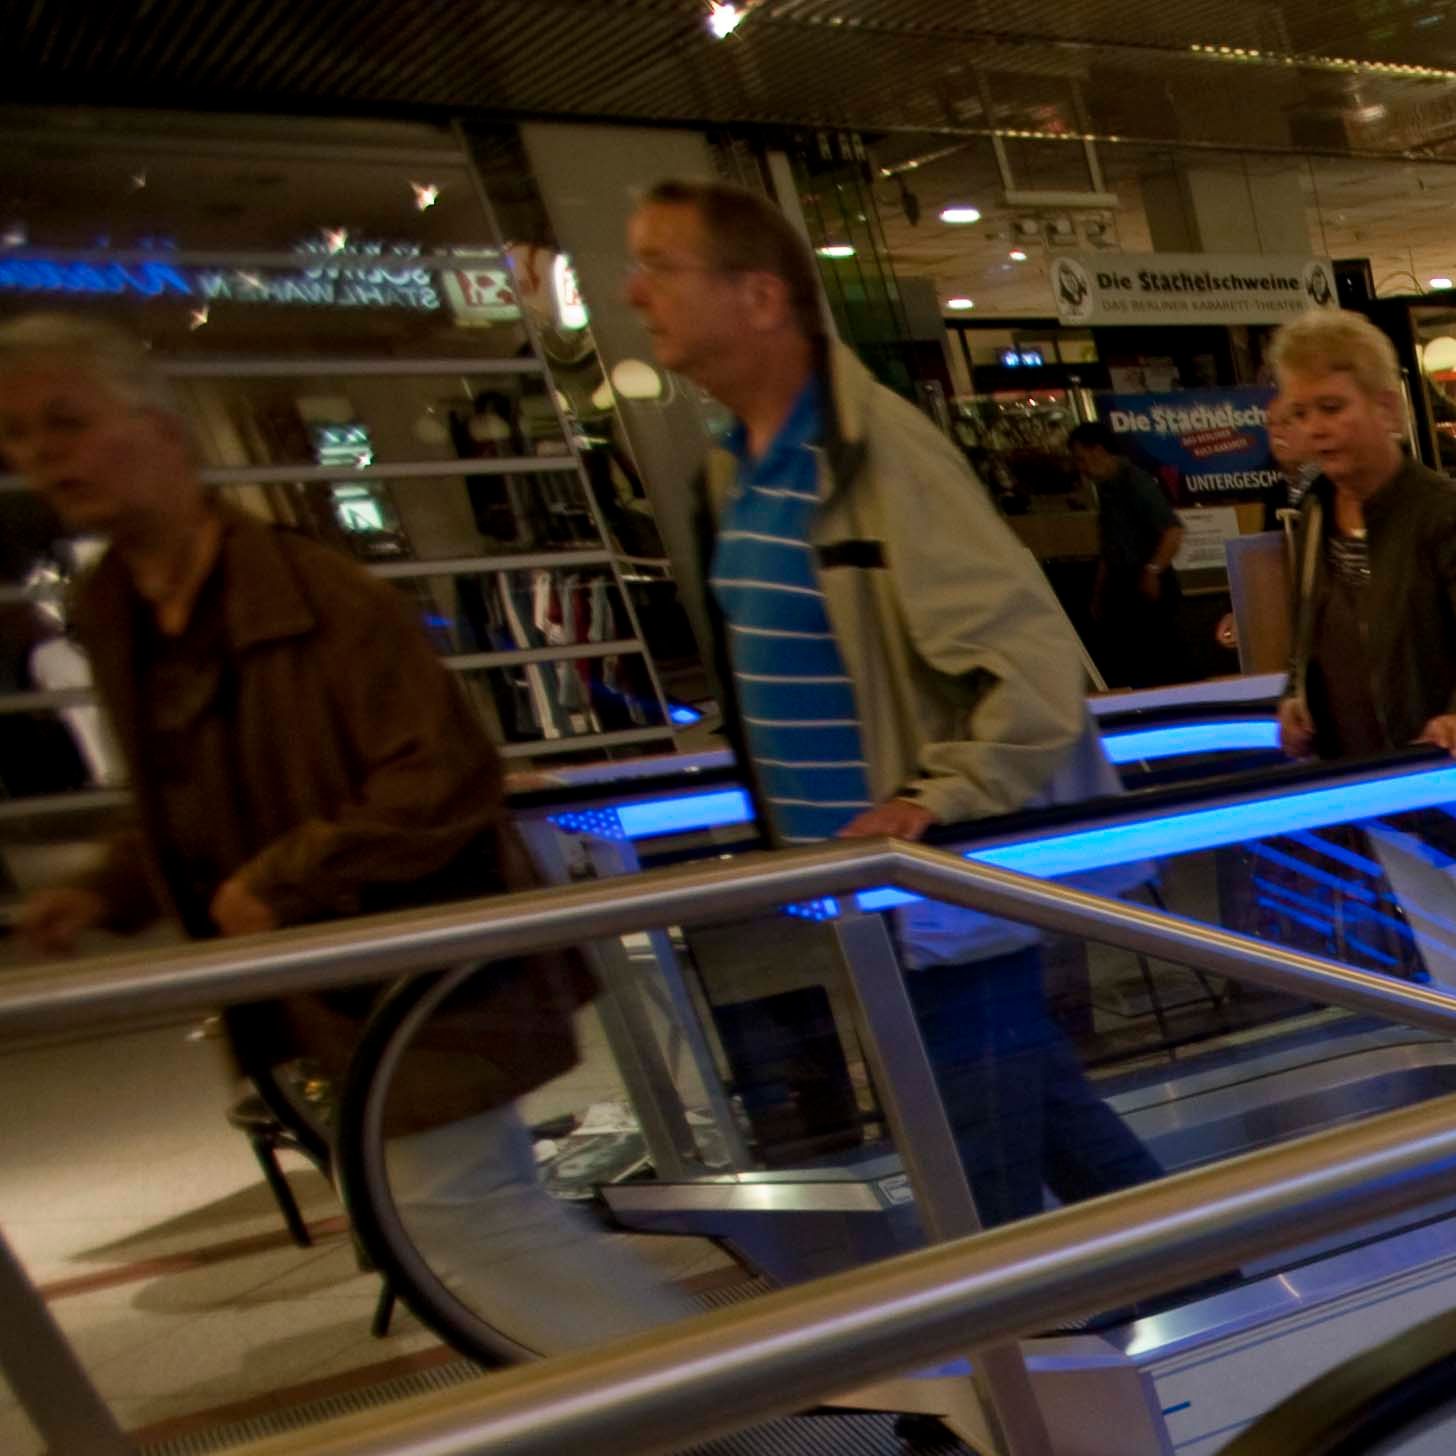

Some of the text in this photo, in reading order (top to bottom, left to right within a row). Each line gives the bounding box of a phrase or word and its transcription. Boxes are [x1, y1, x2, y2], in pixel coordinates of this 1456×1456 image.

[1097, 268, 1300, 293] Die Stachelschweine
[1110, 410, 1150, 433] Die
